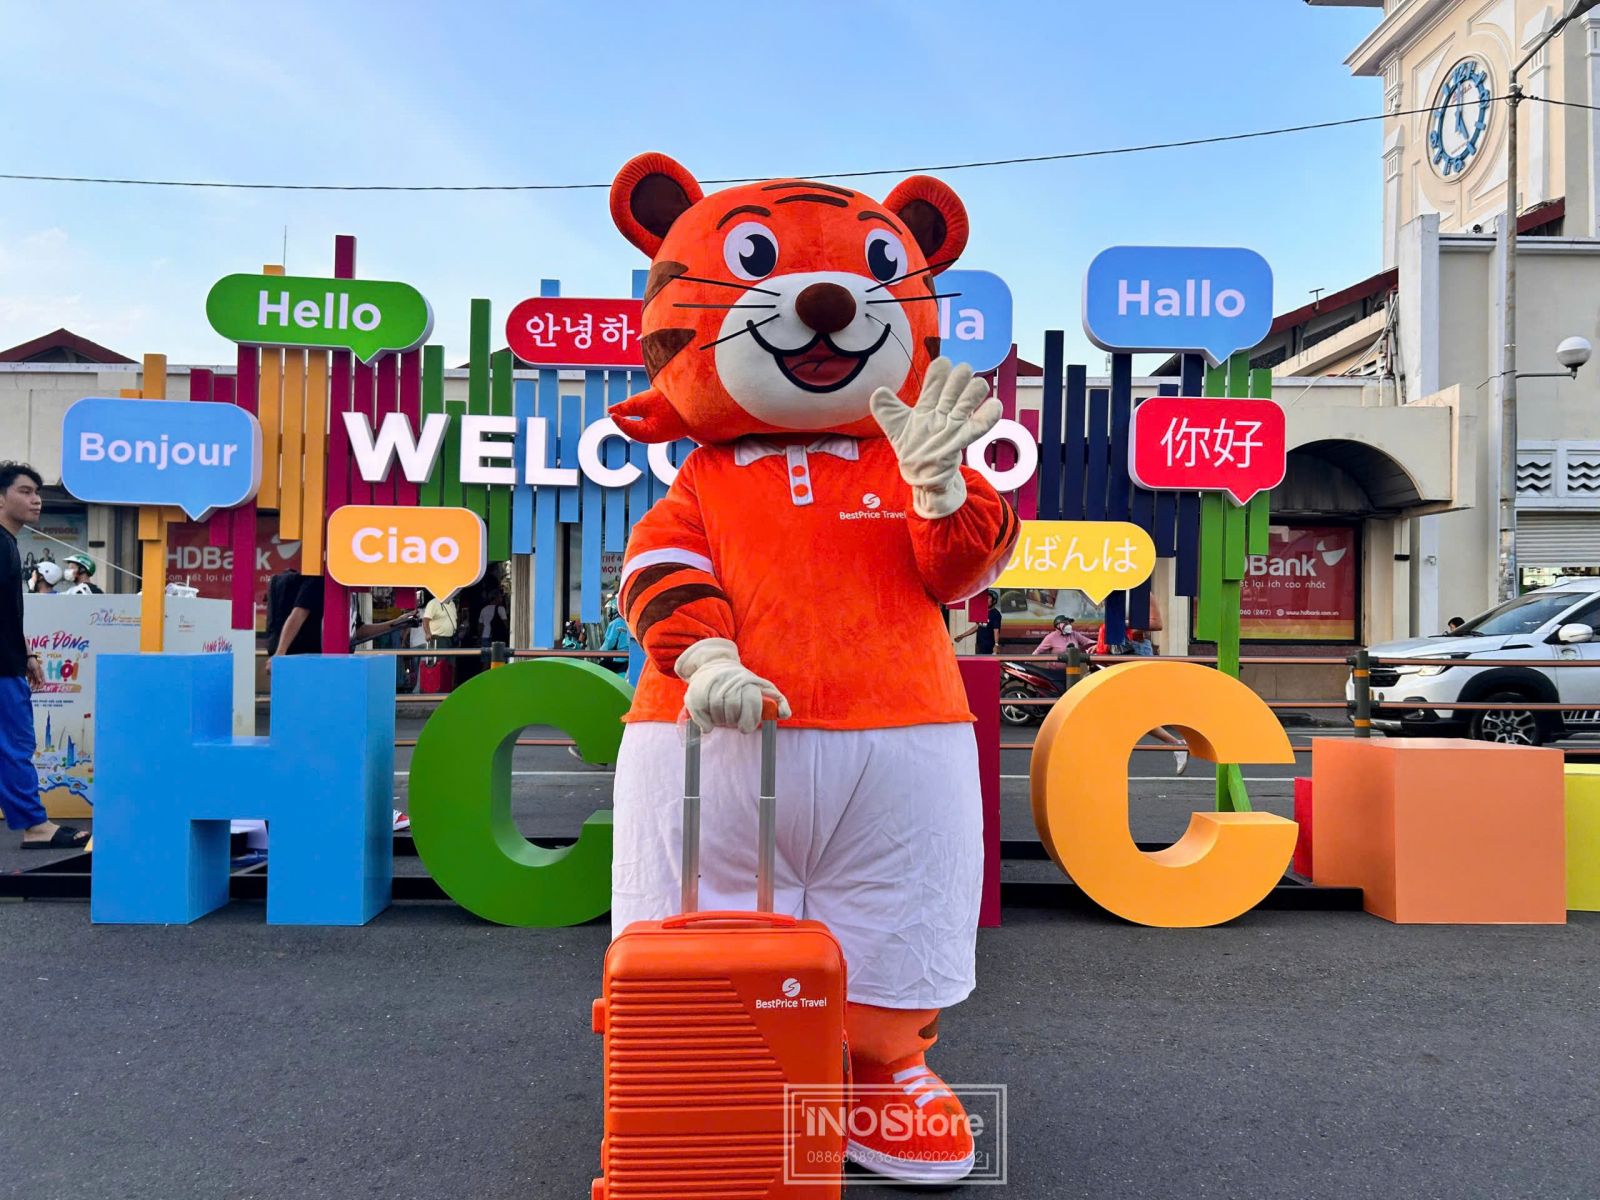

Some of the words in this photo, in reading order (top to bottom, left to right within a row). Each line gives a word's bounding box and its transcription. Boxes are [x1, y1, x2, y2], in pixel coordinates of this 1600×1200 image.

[258, 290, 381, 331] Hello
[1117, 279, 1245, 317] Hallo
[526, 313, 642, 351] 안녕하
[941, 297, 985, 340] la
[79, 432, 237, 470] Bonjour
[342, 411, 679, 488] WELC
[966, 419, 1038, 491] O
[1160, 417, 1263, 469] 你好
[839, 511, 880, 520] BestPrice
[881, 510, 907, 519] Travel
[166, 546, 272, 570] HDBak
[351, 527, 459, 564] Ciao
[1005, 535, 1138, 573] ばんは
[1244, 554, 1317, 576] Bank
[91, 655, 1298, 928] HCC
[755, 999, 798, 1009] BestPrice
[800, 997, 827, 1007] Travel
